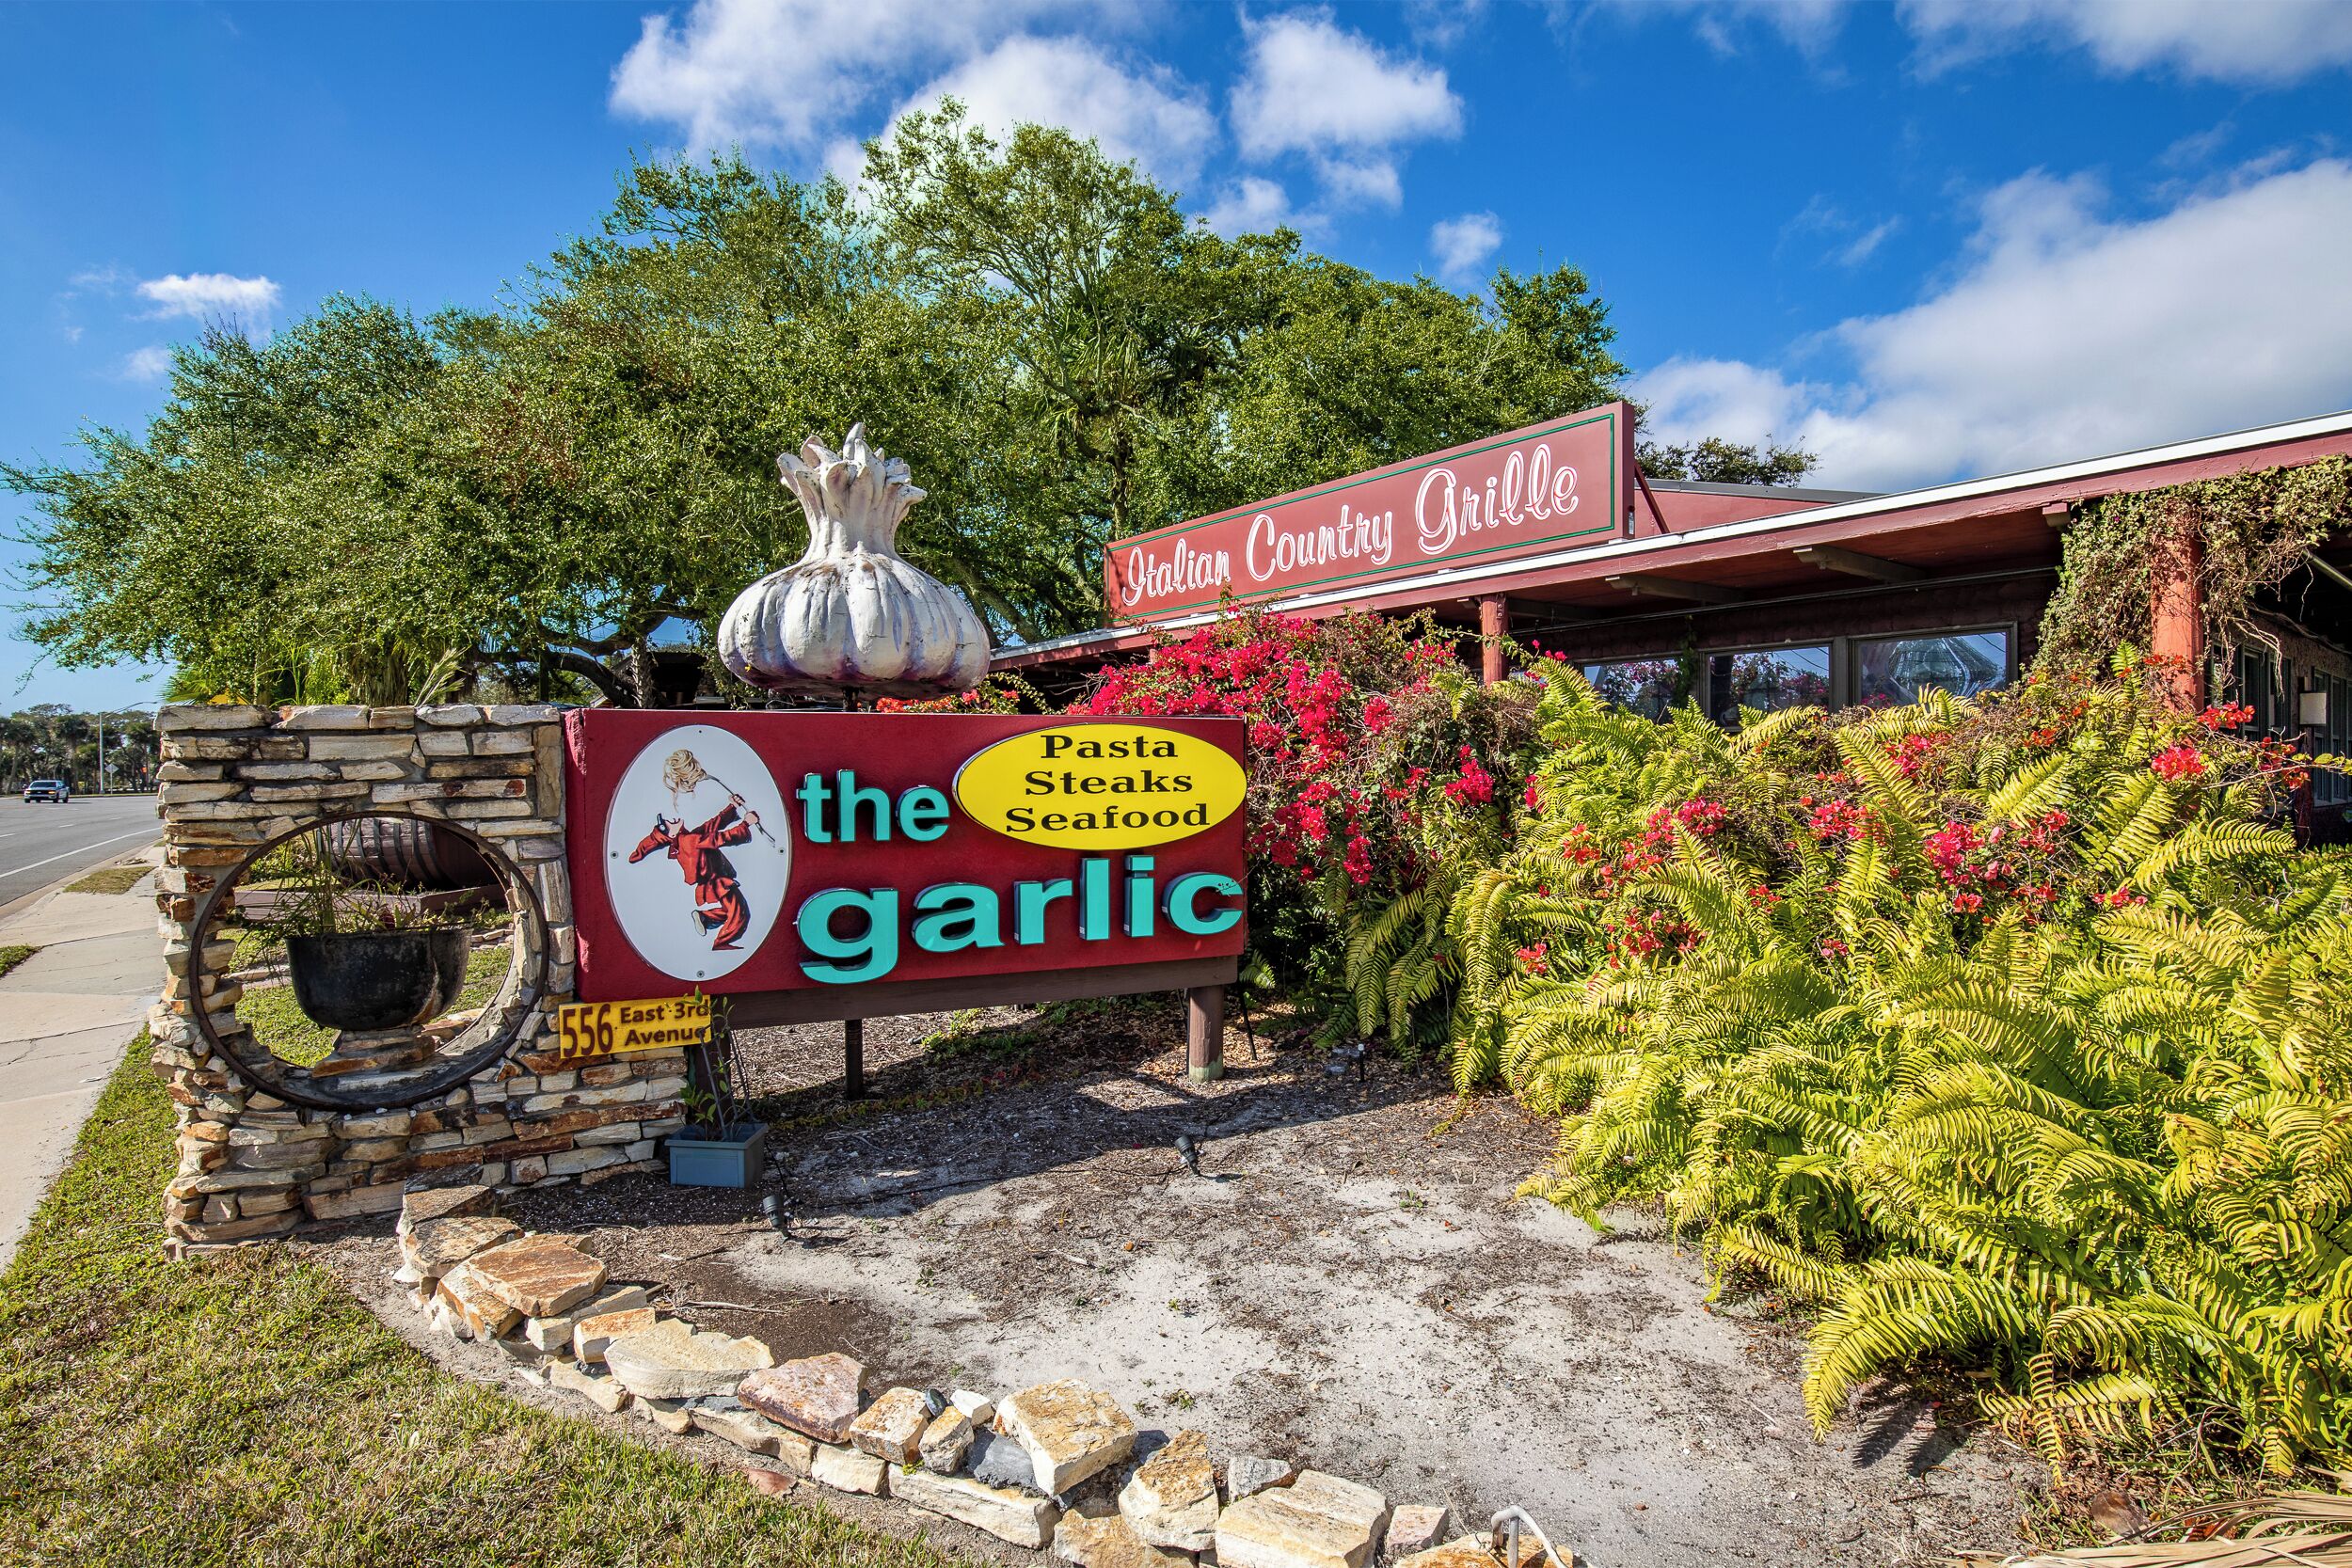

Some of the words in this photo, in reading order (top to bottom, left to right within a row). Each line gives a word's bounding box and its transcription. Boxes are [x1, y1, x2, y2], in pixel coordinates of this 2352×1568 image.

[1121, 537, 1231, 607] Italian
[1246, 504, 1393, 581] Country
[1415, 443, 1580, 555] Grille
[1041, 735, 1178, 759] Pasta
[1025, 769, 1193, 796] Steaks
[796, 769, 951, 844] the
[1005, 803, 1211, 832] Seafood
[796, 854, 1244, 985] garlic
[563, 1004, 612, 1057] 556
[620, 1005, 665, 1024] East
[674, 999, 708, 1020] 3rd
